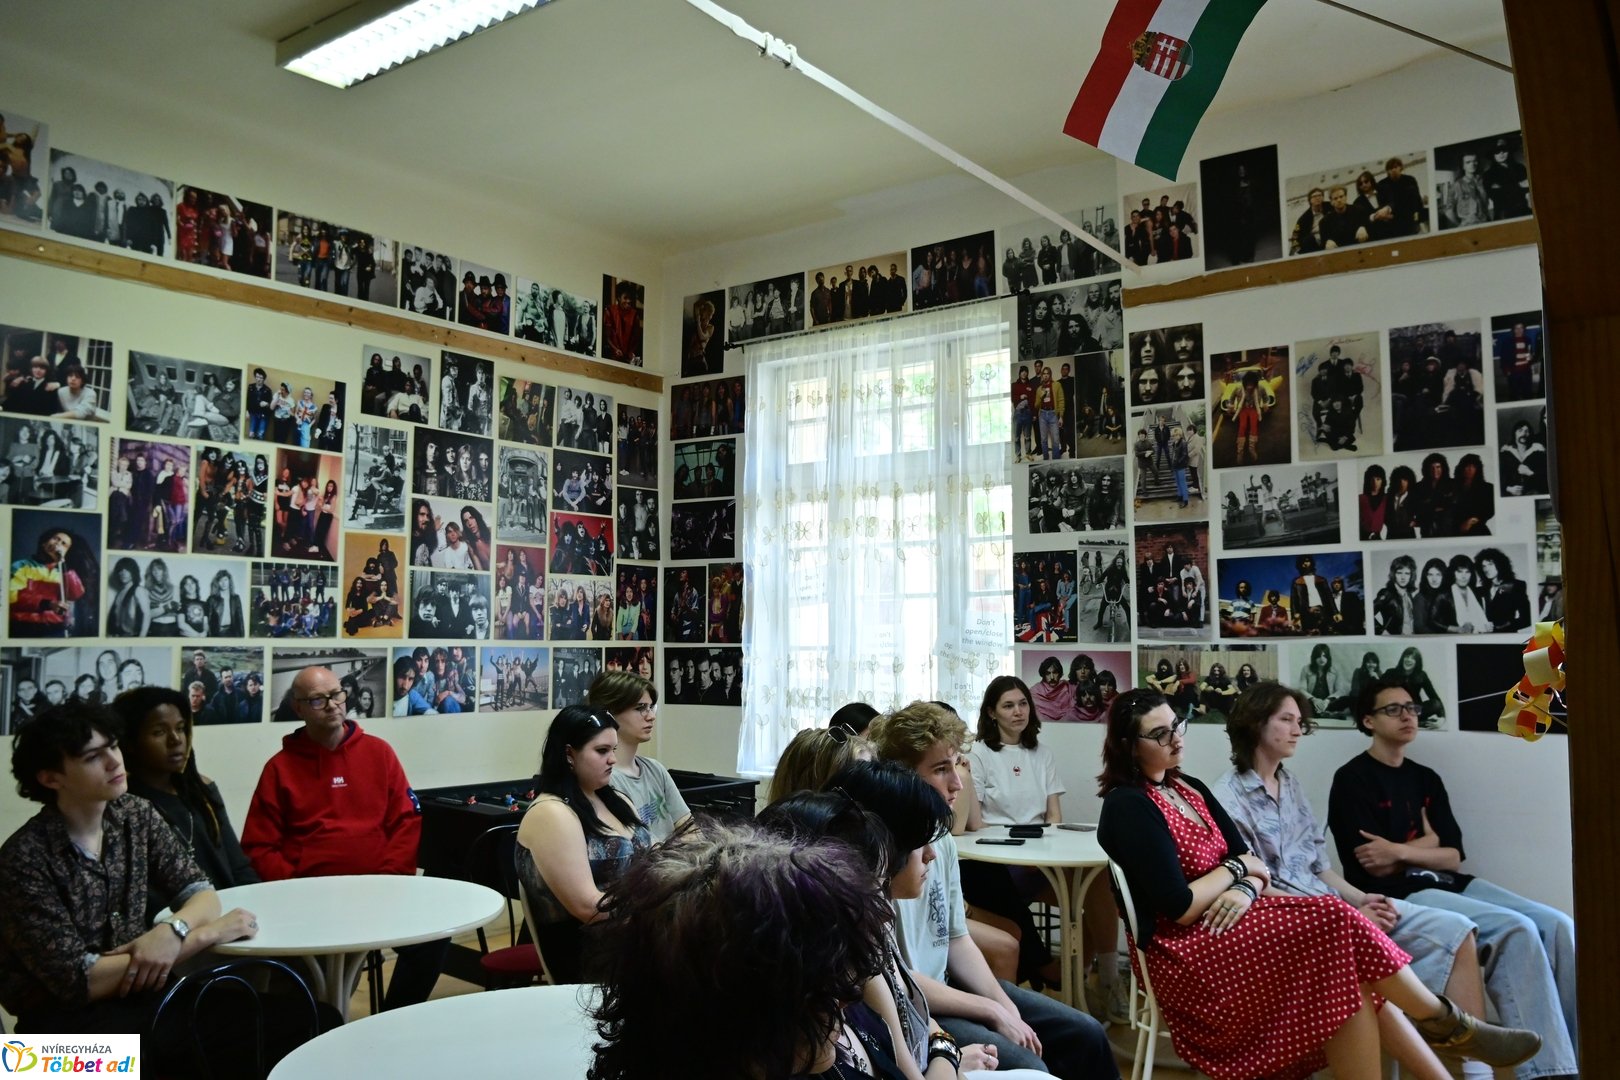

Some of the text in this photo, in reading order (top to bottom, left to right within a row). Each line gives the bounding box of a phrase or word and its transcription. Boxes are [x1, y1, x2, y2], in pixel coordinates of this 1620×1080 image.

[976, 618, 996, 626] Don't
[965, 628, 1003, 637] open/close
[975, 639, 1004, 648] window
